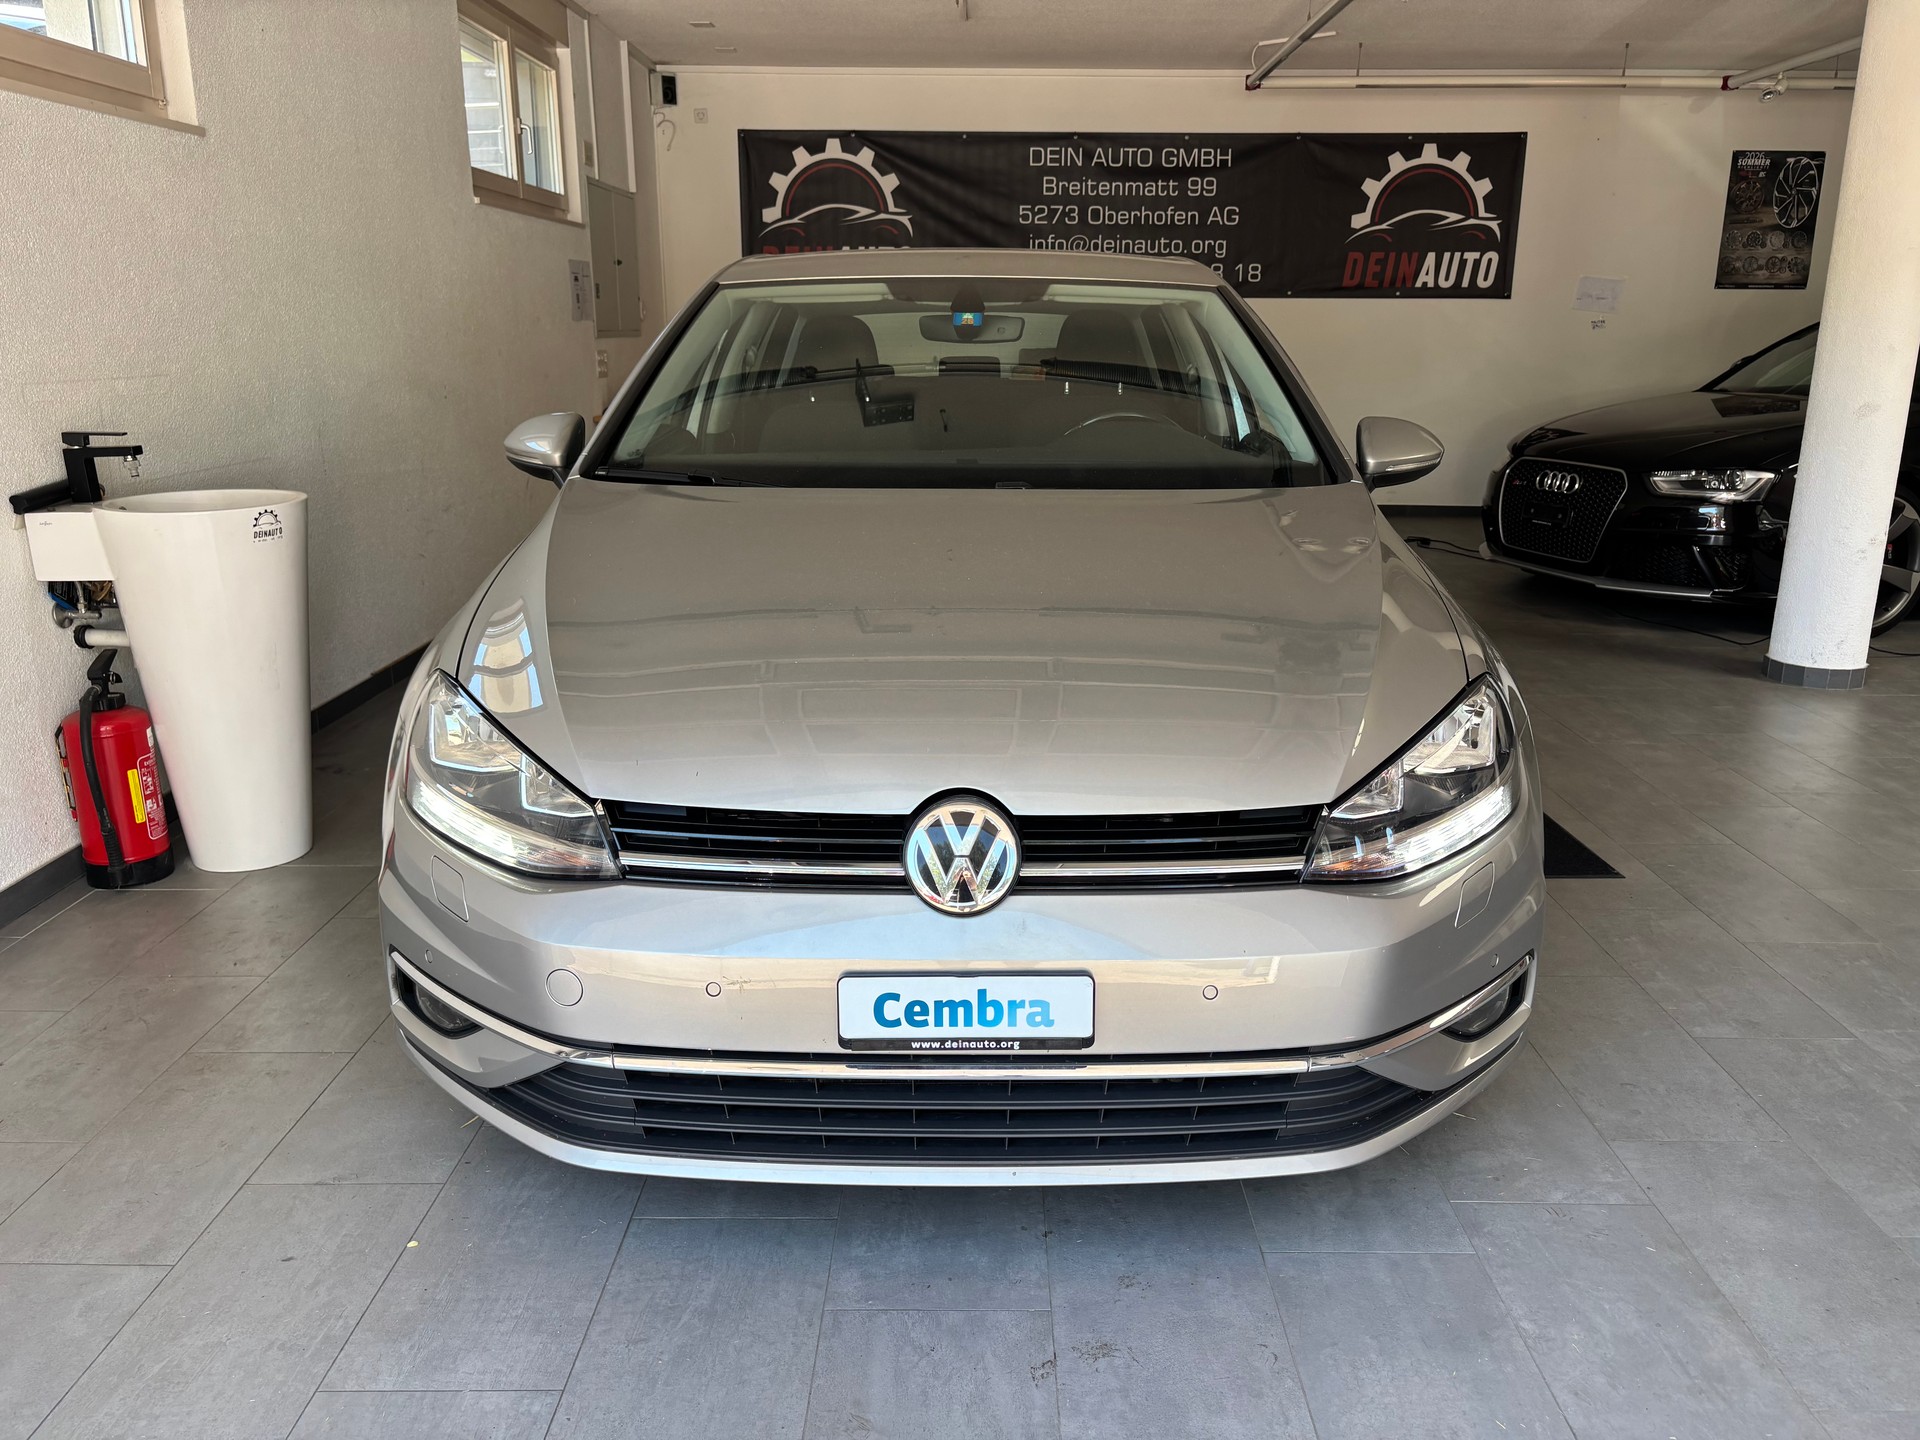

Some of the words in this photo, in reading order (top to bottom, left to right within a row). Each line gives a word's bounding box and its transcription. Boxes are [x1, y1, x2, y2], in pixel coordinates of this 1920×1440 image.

[1029, 147, 1083, 167] DEIN
[1091, 148, 1153, 168] AUTO
[1161, 148, 1232, 168] GMBH
[1042, 176, 1179, 197] Breitenmatt
[1187, 177, 1217, 197] 99
[1019, 205, 1079, 225] 5273
[1087, 205, 1199, 226] Oberhofen
[1206, 206, 1240, 225] AG
[1029, 234, 1228, 259] info@deinauto.org
[1234, 263, 1262, 283] 18
[1342, 251, 1500, 289] DEINAUTO
[873, 989, 1055, 1028] Cembra
[911, 1040, 1021, 1050] www.deinauto.org
